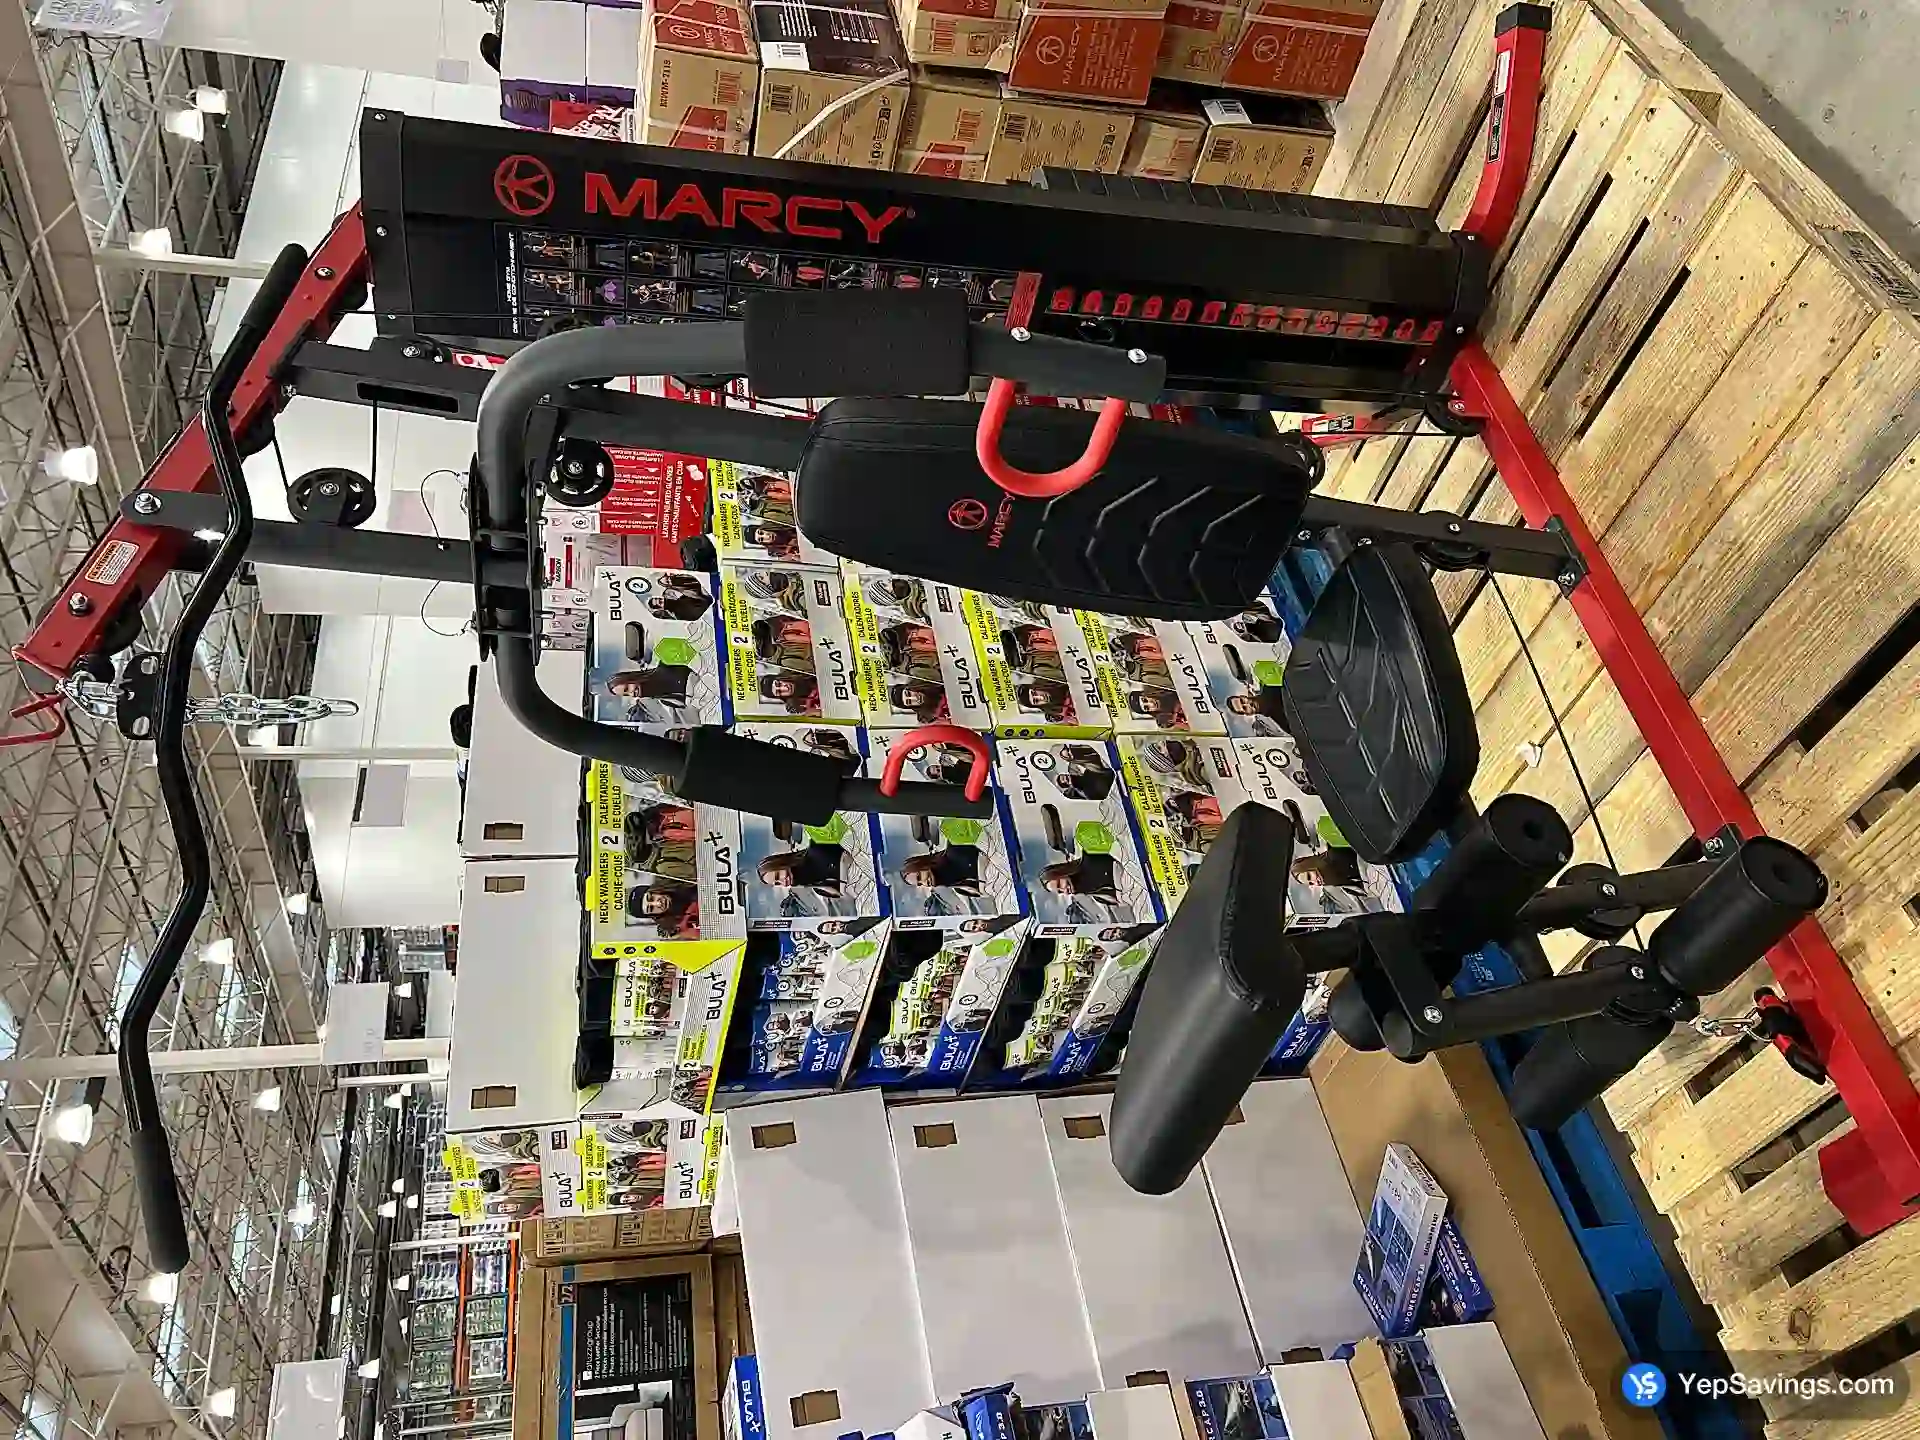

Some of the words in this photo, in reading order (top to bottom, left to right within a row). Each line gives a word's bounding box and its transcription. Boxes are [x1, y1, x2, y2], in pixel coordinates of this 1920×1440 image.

[1062, 20, 1082, 84] MARCY
[584, 171, 904, 244] MARCY
[664, 490, 672, 512] HEATED
[670, 524, 678, 543] GANTS
[676, 460, 684, 475] CUIR
[662, 514, 670, 538] LEATHER
[988, 492, 1016, 548] MARCY
[726, 583, 738, 628] CALENTADORES
[739, 600, 748, 622] CUELLO
[852, 592, 865, 638] CALENTADORES
[972, 594, 988, 640] CALENTADORES
[742, 623, 749, 632] DE
[864, 608, 874, 630] CUELLO
[986, 610, 996, 632] CUELLO
[1092, 619, 1104, 640] CUELLO
[734, 636, 748, 644] 2
[868, 632, 876, 640] DE
[990, 634, 999, 642] DE
[1100, 642, 1107, 650] DE
[862, 645, 876, 653] 2
[987, 646, 1000, 654] 2
[1095, 654, 1108, 662] 2
[733, 648, 744, 682] WARMERS
[744, 650, 756, 692] CACHE-COUS
[862, 658, 875, 692] WARMERS
[988, 660, 1003, 692] WARMERS
[736, 683, 746, 700] NECK
[874, 660, 887, 702] CACHE-COUS
[1000, 660, 1015, 702] CACHE-COUS
[1108, 668, 1126, 708] CACHE-COUS
[868, 693, 878, 712] NECK
[995, 693, 1006, 710] NECK
[600, 764, 608, 824] CALENTADORES
[612, 786, 621, 816] CUELLO
[1144, 776, 1159, 802] CUELLO
[1152, 804, 1162, 814] DE
[614, 818, 622, 828] DE
[1150, 820, 1164, 828] 2
[602, 836, 618, 844] 2
[1152, 834, 1170, 874] WARMERS
[1164, 836, 1186, 886] CACHE-COUS
[600, 852, 608, 896] WARMERS
[613, 856, 623, 910] CACHE-COUS
[716, 846, 735, 914] BULA
[1164, 875, 1178, 897] NECK
[600, 899, 608, 923] NECK
[624, 976, 632, 1007] BULA
[1449, 1230, 1477, 1282] POWERCAP
[1404, 1274, 1422, 1322] POWERCAP
[1196, 1390, 1206, 1408] 3.0
[996, 1412, 1006, 1430] 3.0
